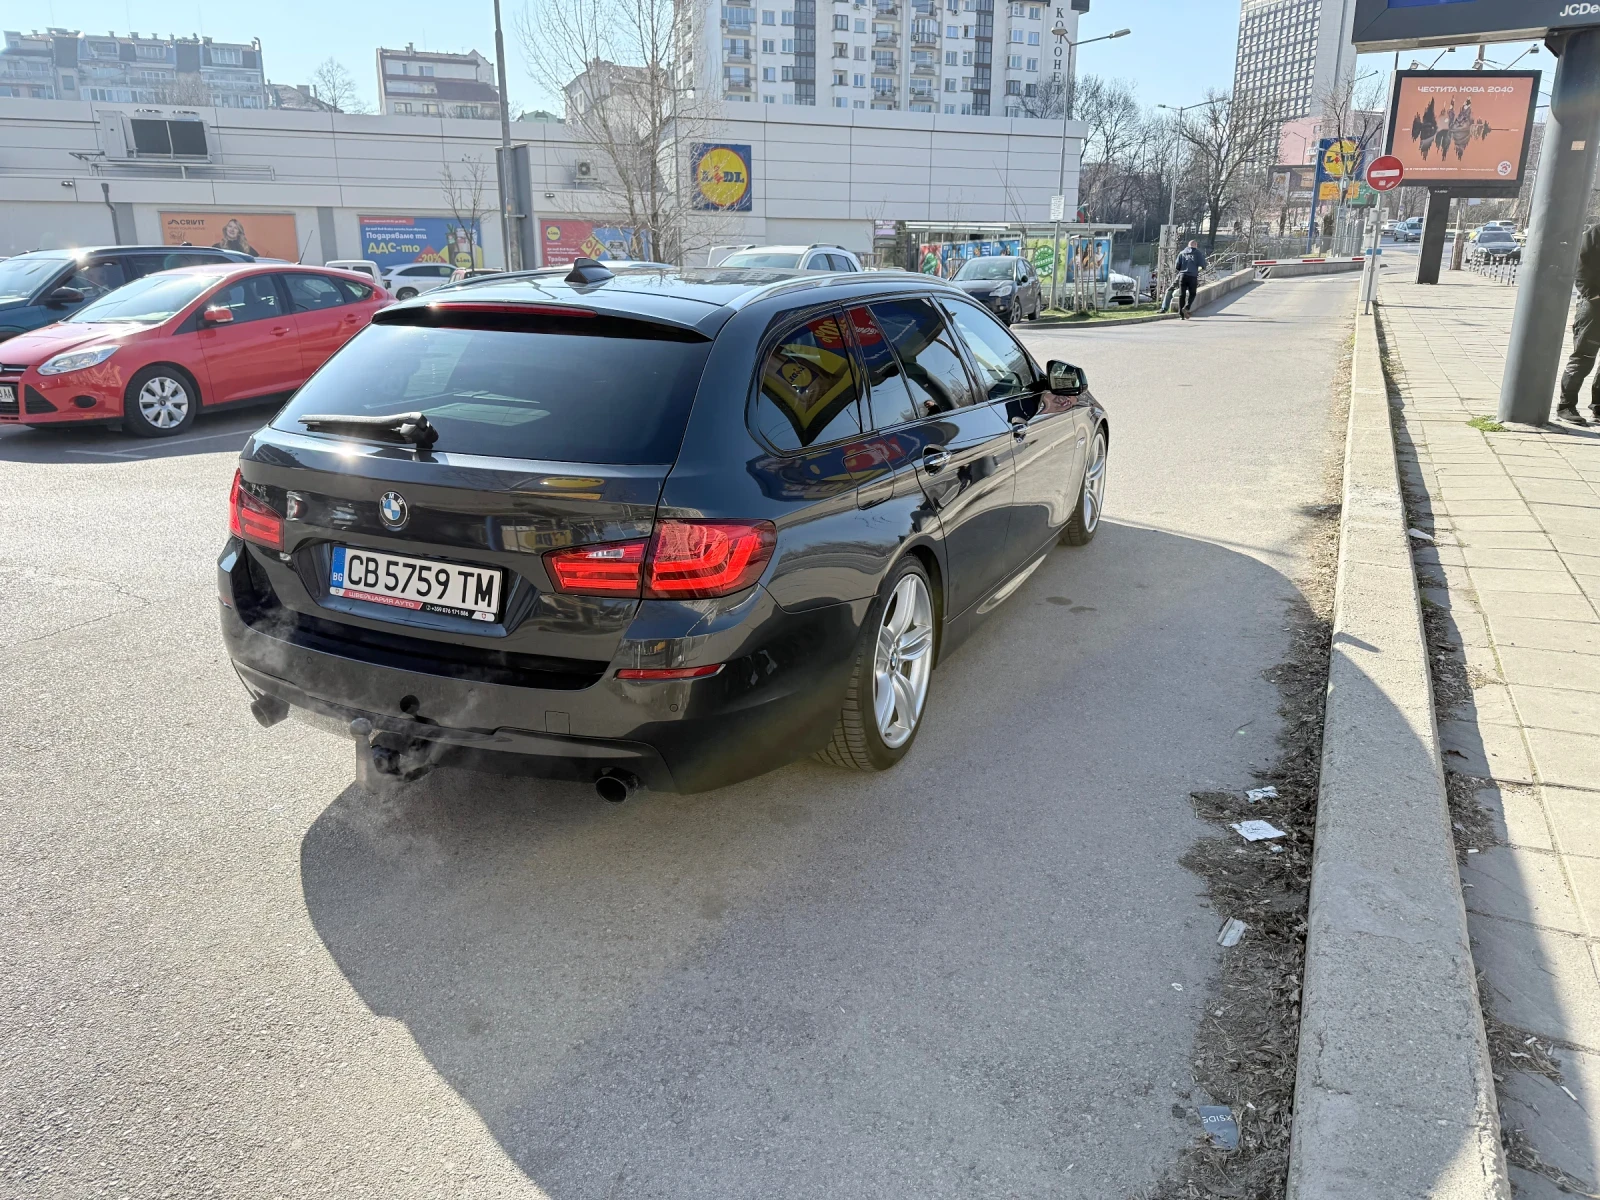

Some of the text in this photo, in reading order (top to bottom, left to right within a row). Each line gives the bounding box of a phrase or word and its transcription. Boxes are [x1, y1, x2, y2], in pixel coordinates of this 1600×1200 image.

[1560, 3, 1600, 17] JCDe
[366, 232, 414, 240] Подаряваме
[418, 253, 441, 264] -20%
[332, 572, 344, 582] BG
[347, 554, 495, 608] CB 5759 TM
[348, 591, 394, 604] ШВЕЙЦАРИЯ
